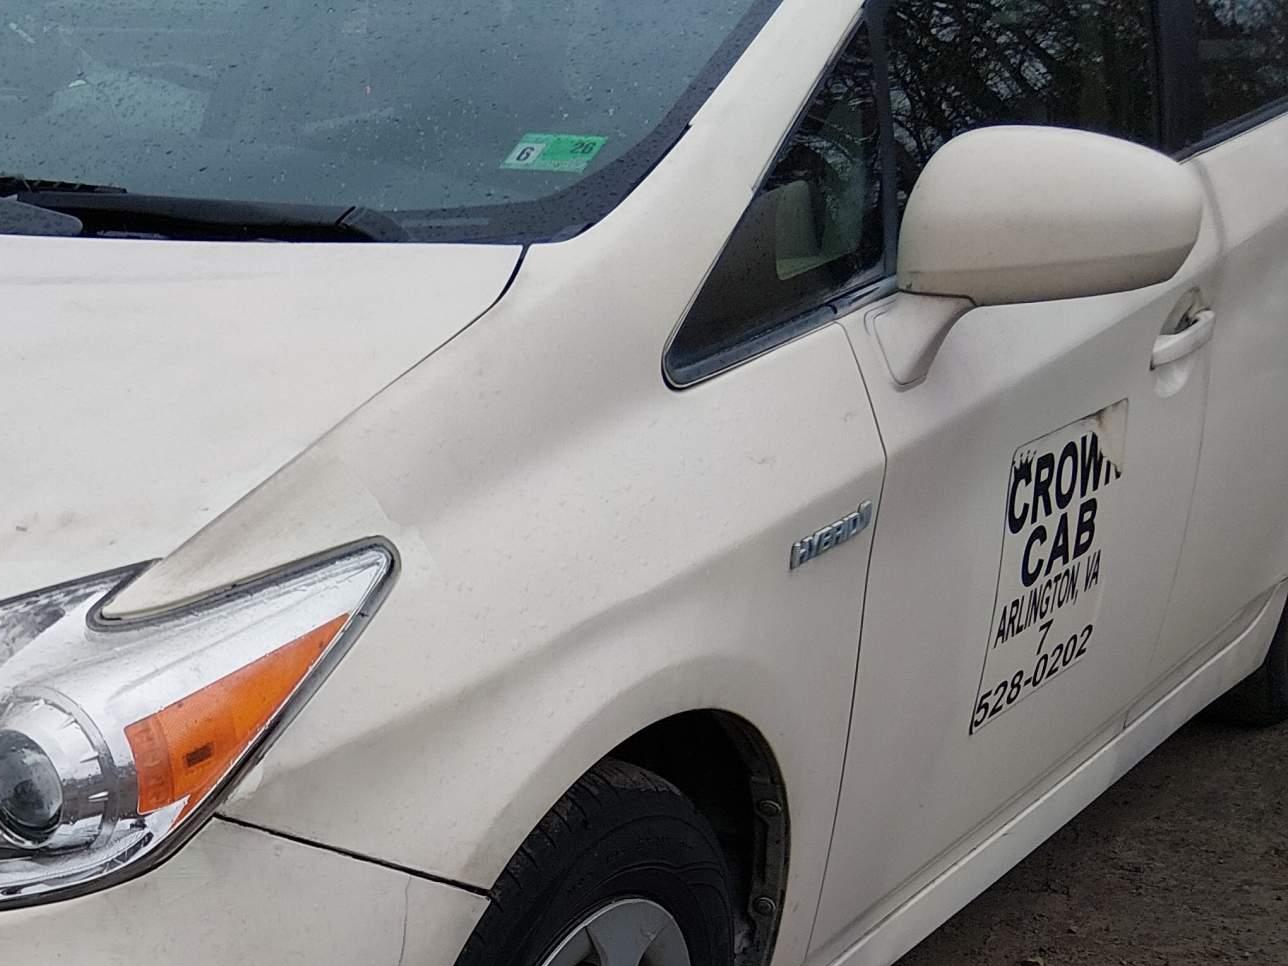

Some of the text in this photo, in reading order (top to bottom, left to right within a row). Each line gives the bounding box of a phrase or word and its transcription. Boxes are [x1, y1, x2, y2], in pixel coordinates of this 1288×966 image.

[516, 146, 534, 161] 6
[1021, 497, 1098, 588] CAB
[994, 549, 1102, 649] ARLINGTON, VA
[1036, 618, 1054, 656] 7
[974, 624, 1094, 728] 528-0202
